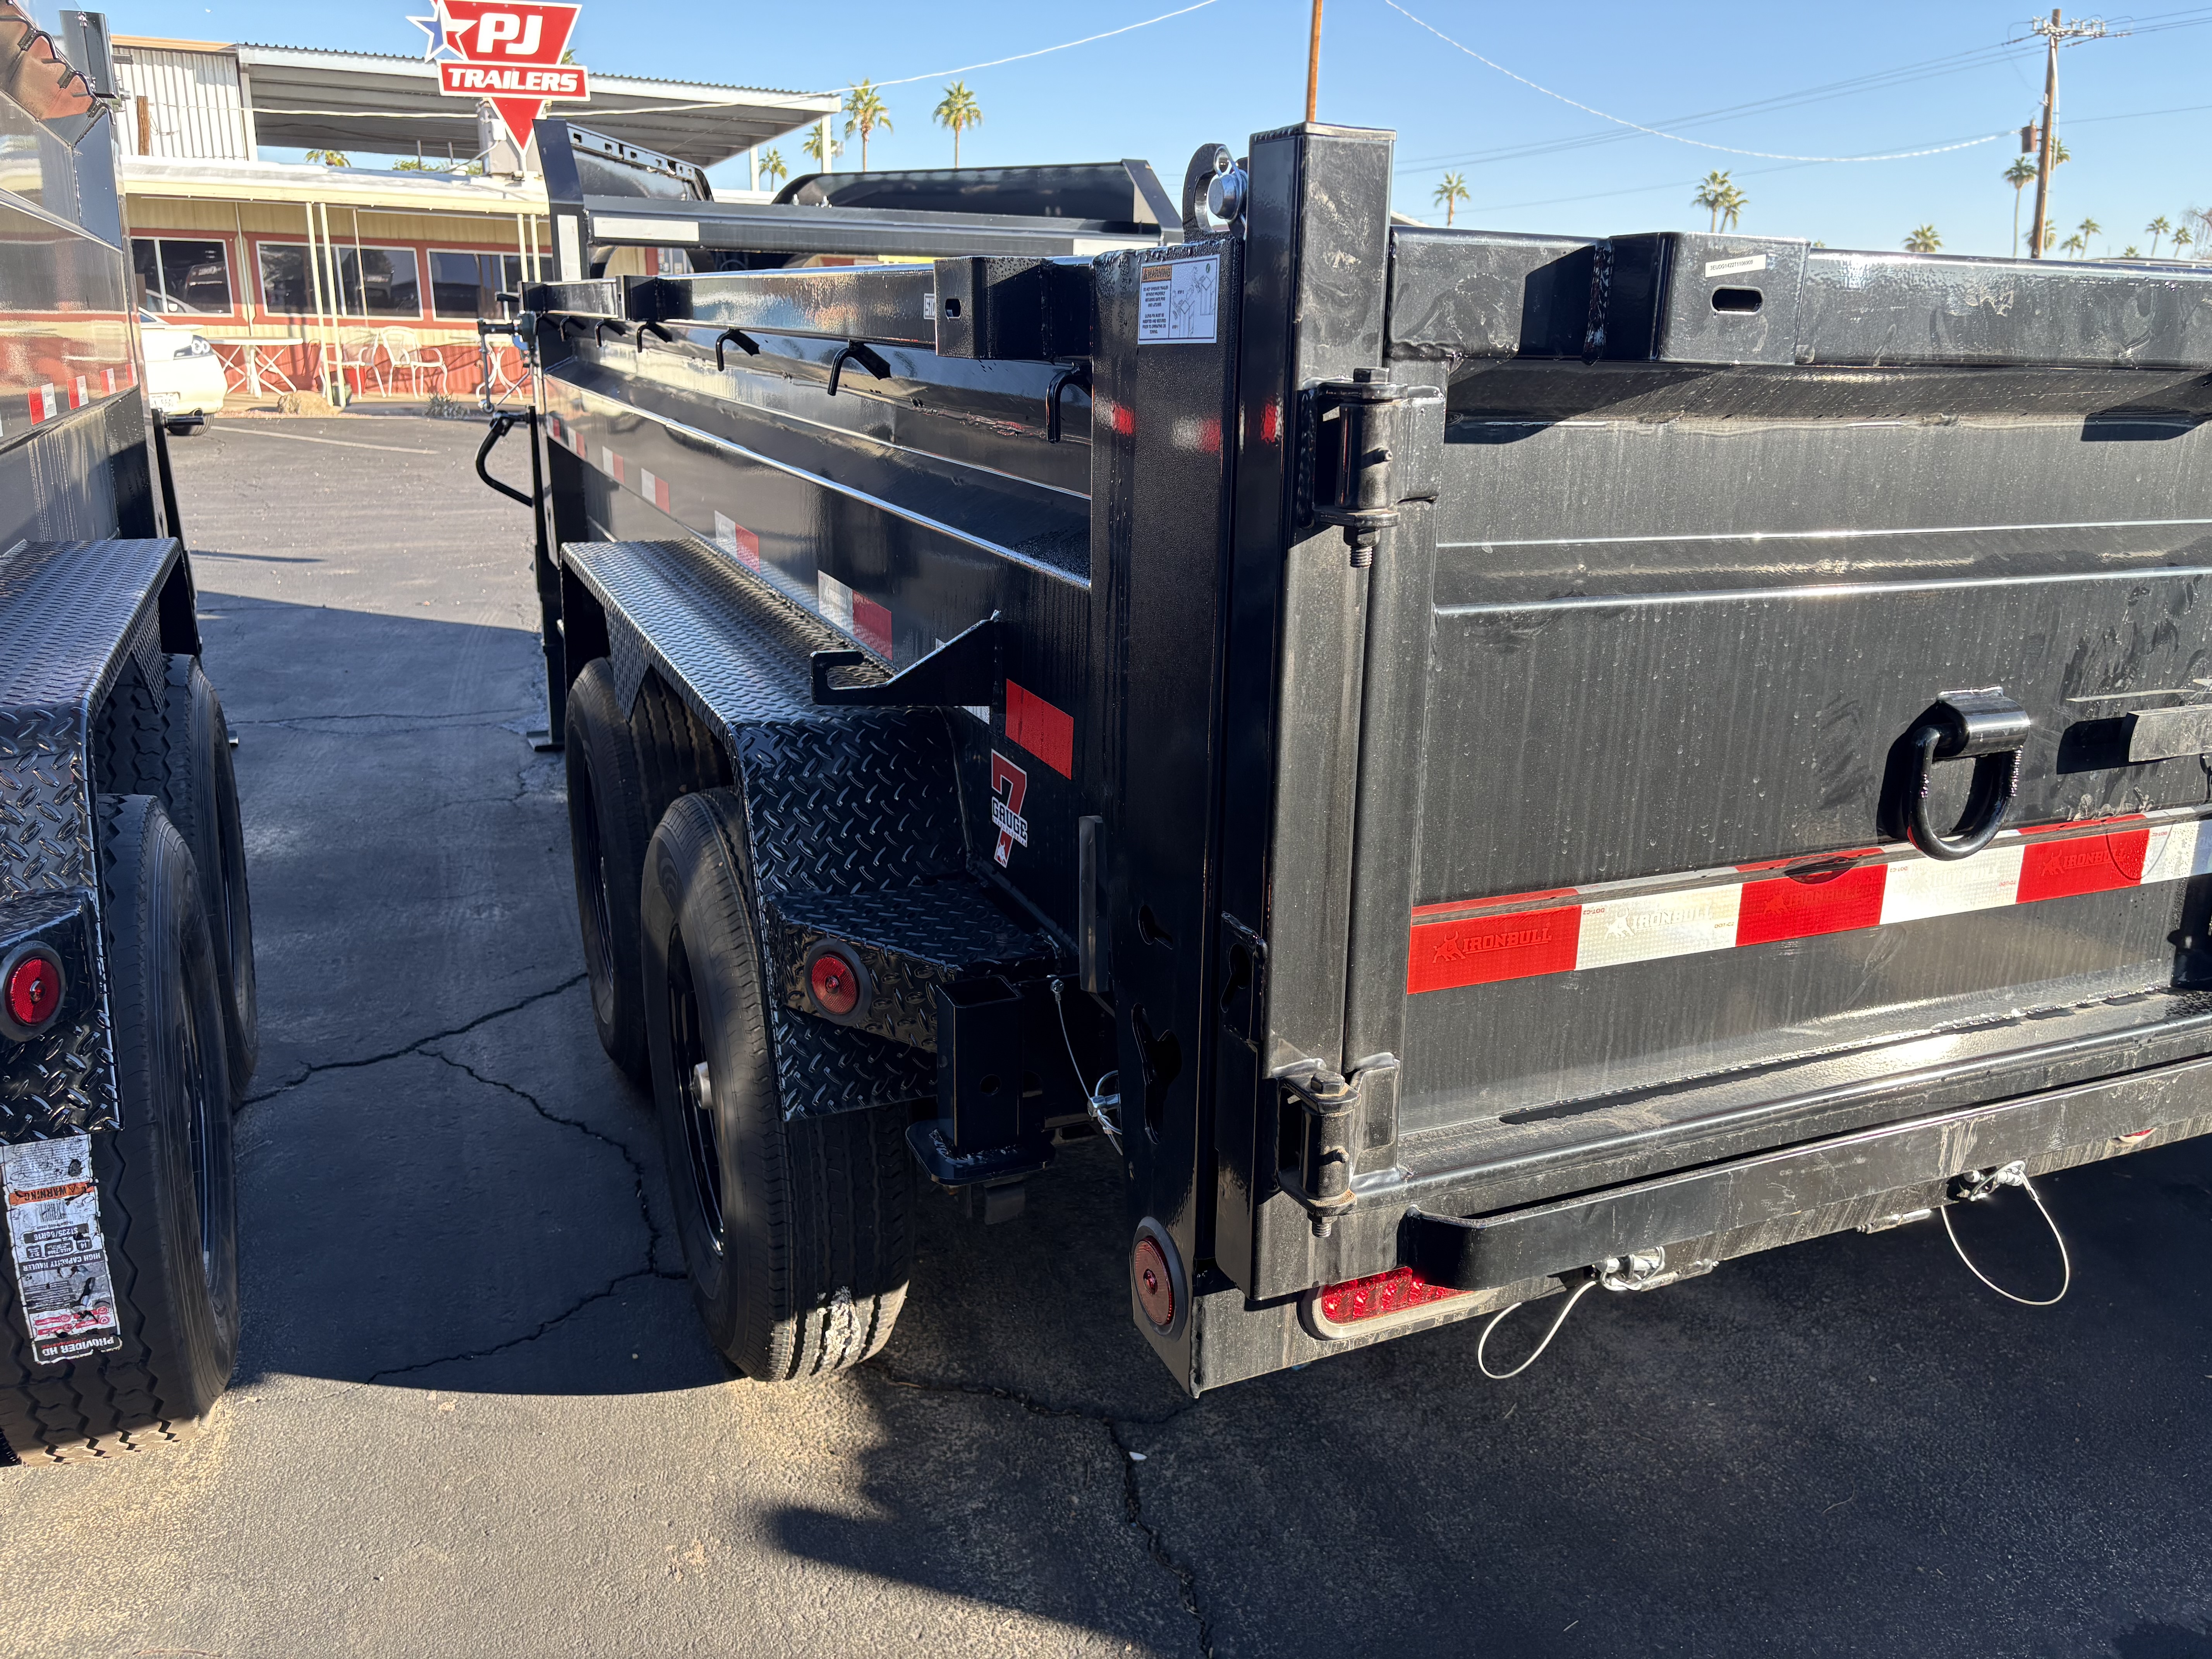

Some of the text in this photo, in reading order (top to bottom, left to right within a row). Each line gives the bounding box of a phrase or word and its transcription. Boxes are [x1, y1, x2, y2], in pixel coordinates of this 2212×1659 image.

[476, 12, 543, 55] PJ
[448, 68, 578, 92] TRAILERS
[993, 799, 1026, 841] GAUGE
[2063, 848, 2127, 867] IRONBULL
[1632, 907, 1713, 929] IRONBULL
[1463, 927, 1552, 952] IRONBULL
[24, 1187, 67, 1201] WARNING
[22, 1252, 101, 1271] HIGH CAPACITY HAULER
[42, 1336, 114, 1357] PROVIDER HD
